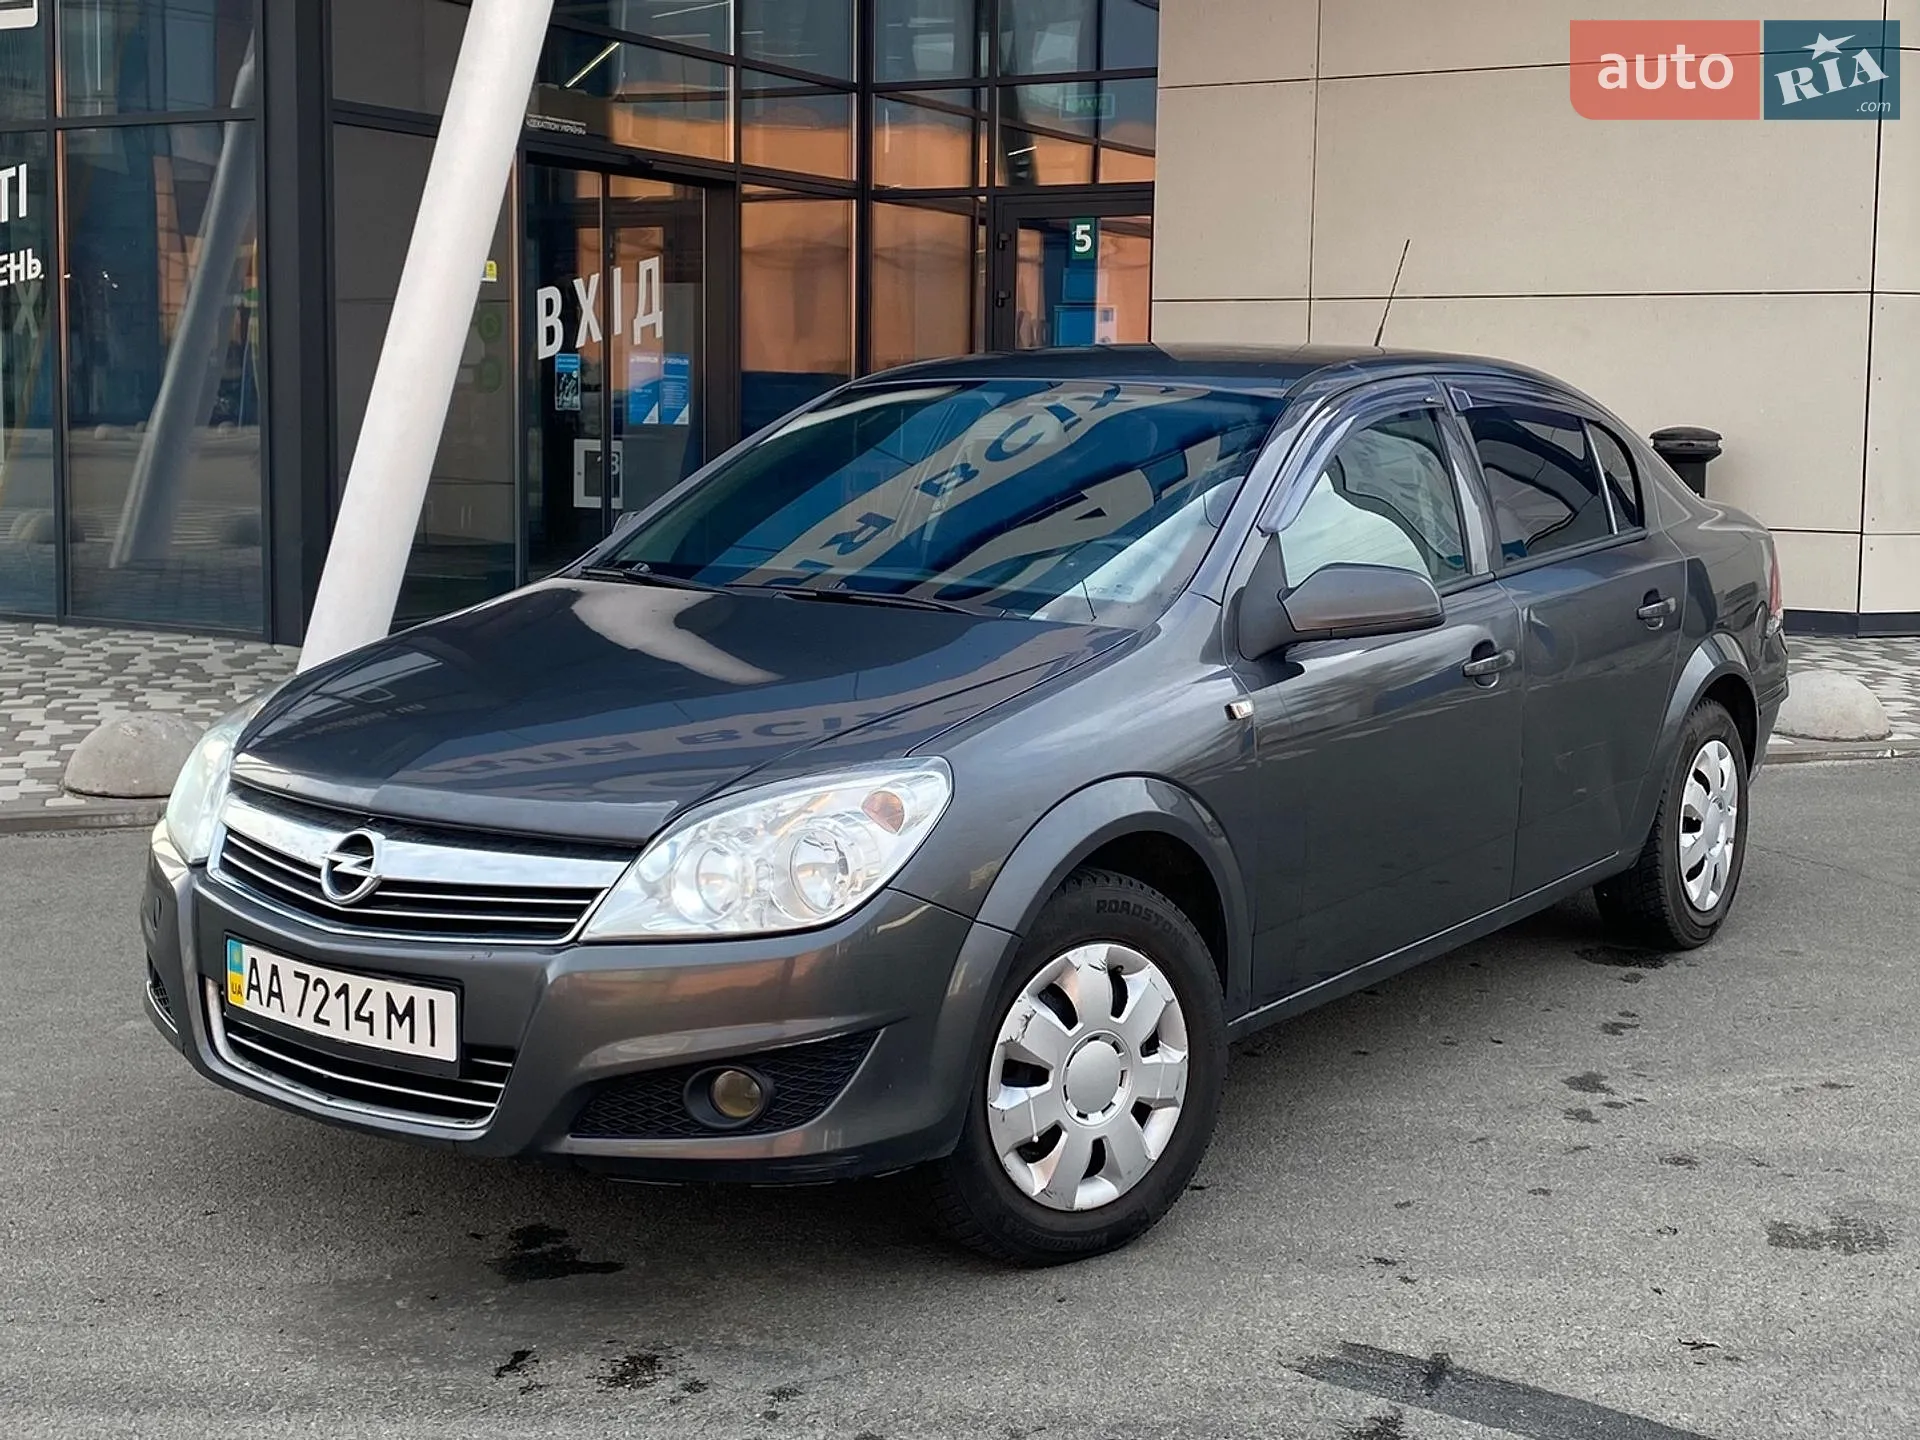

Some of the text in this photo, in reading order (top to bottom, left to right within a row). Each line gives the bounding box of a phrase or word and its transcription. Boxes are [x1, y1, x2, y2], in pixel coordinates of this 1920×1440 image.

[1074, 224, 1092, 253] 5
[536, 255, 664, 360] ВХІД
[231, 982, 242, 998] UA
